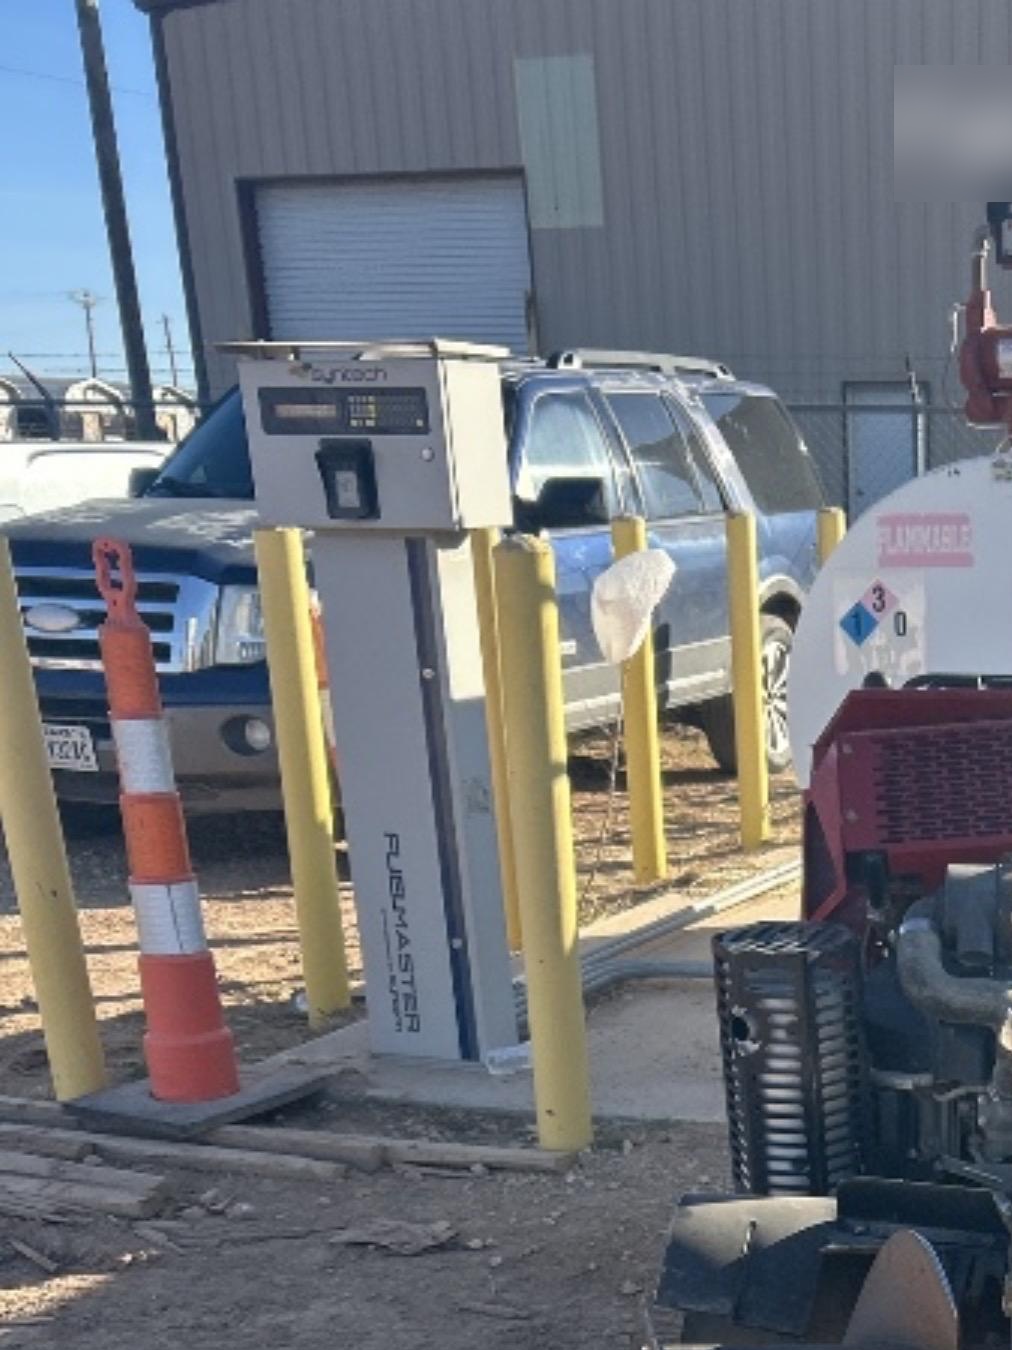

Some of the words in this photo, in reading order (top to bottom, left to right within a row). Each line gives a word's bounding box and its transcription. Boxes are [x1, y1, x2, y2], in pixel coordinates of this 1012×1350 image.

[878, 525, 973, 553] FLAMMABLE
[872, 585, 886, 613] 3
[852, 611, 862, 637] 1
[894, 611, 907, 637] 0
[384, 832, 421, 1033] FUELMASTER
